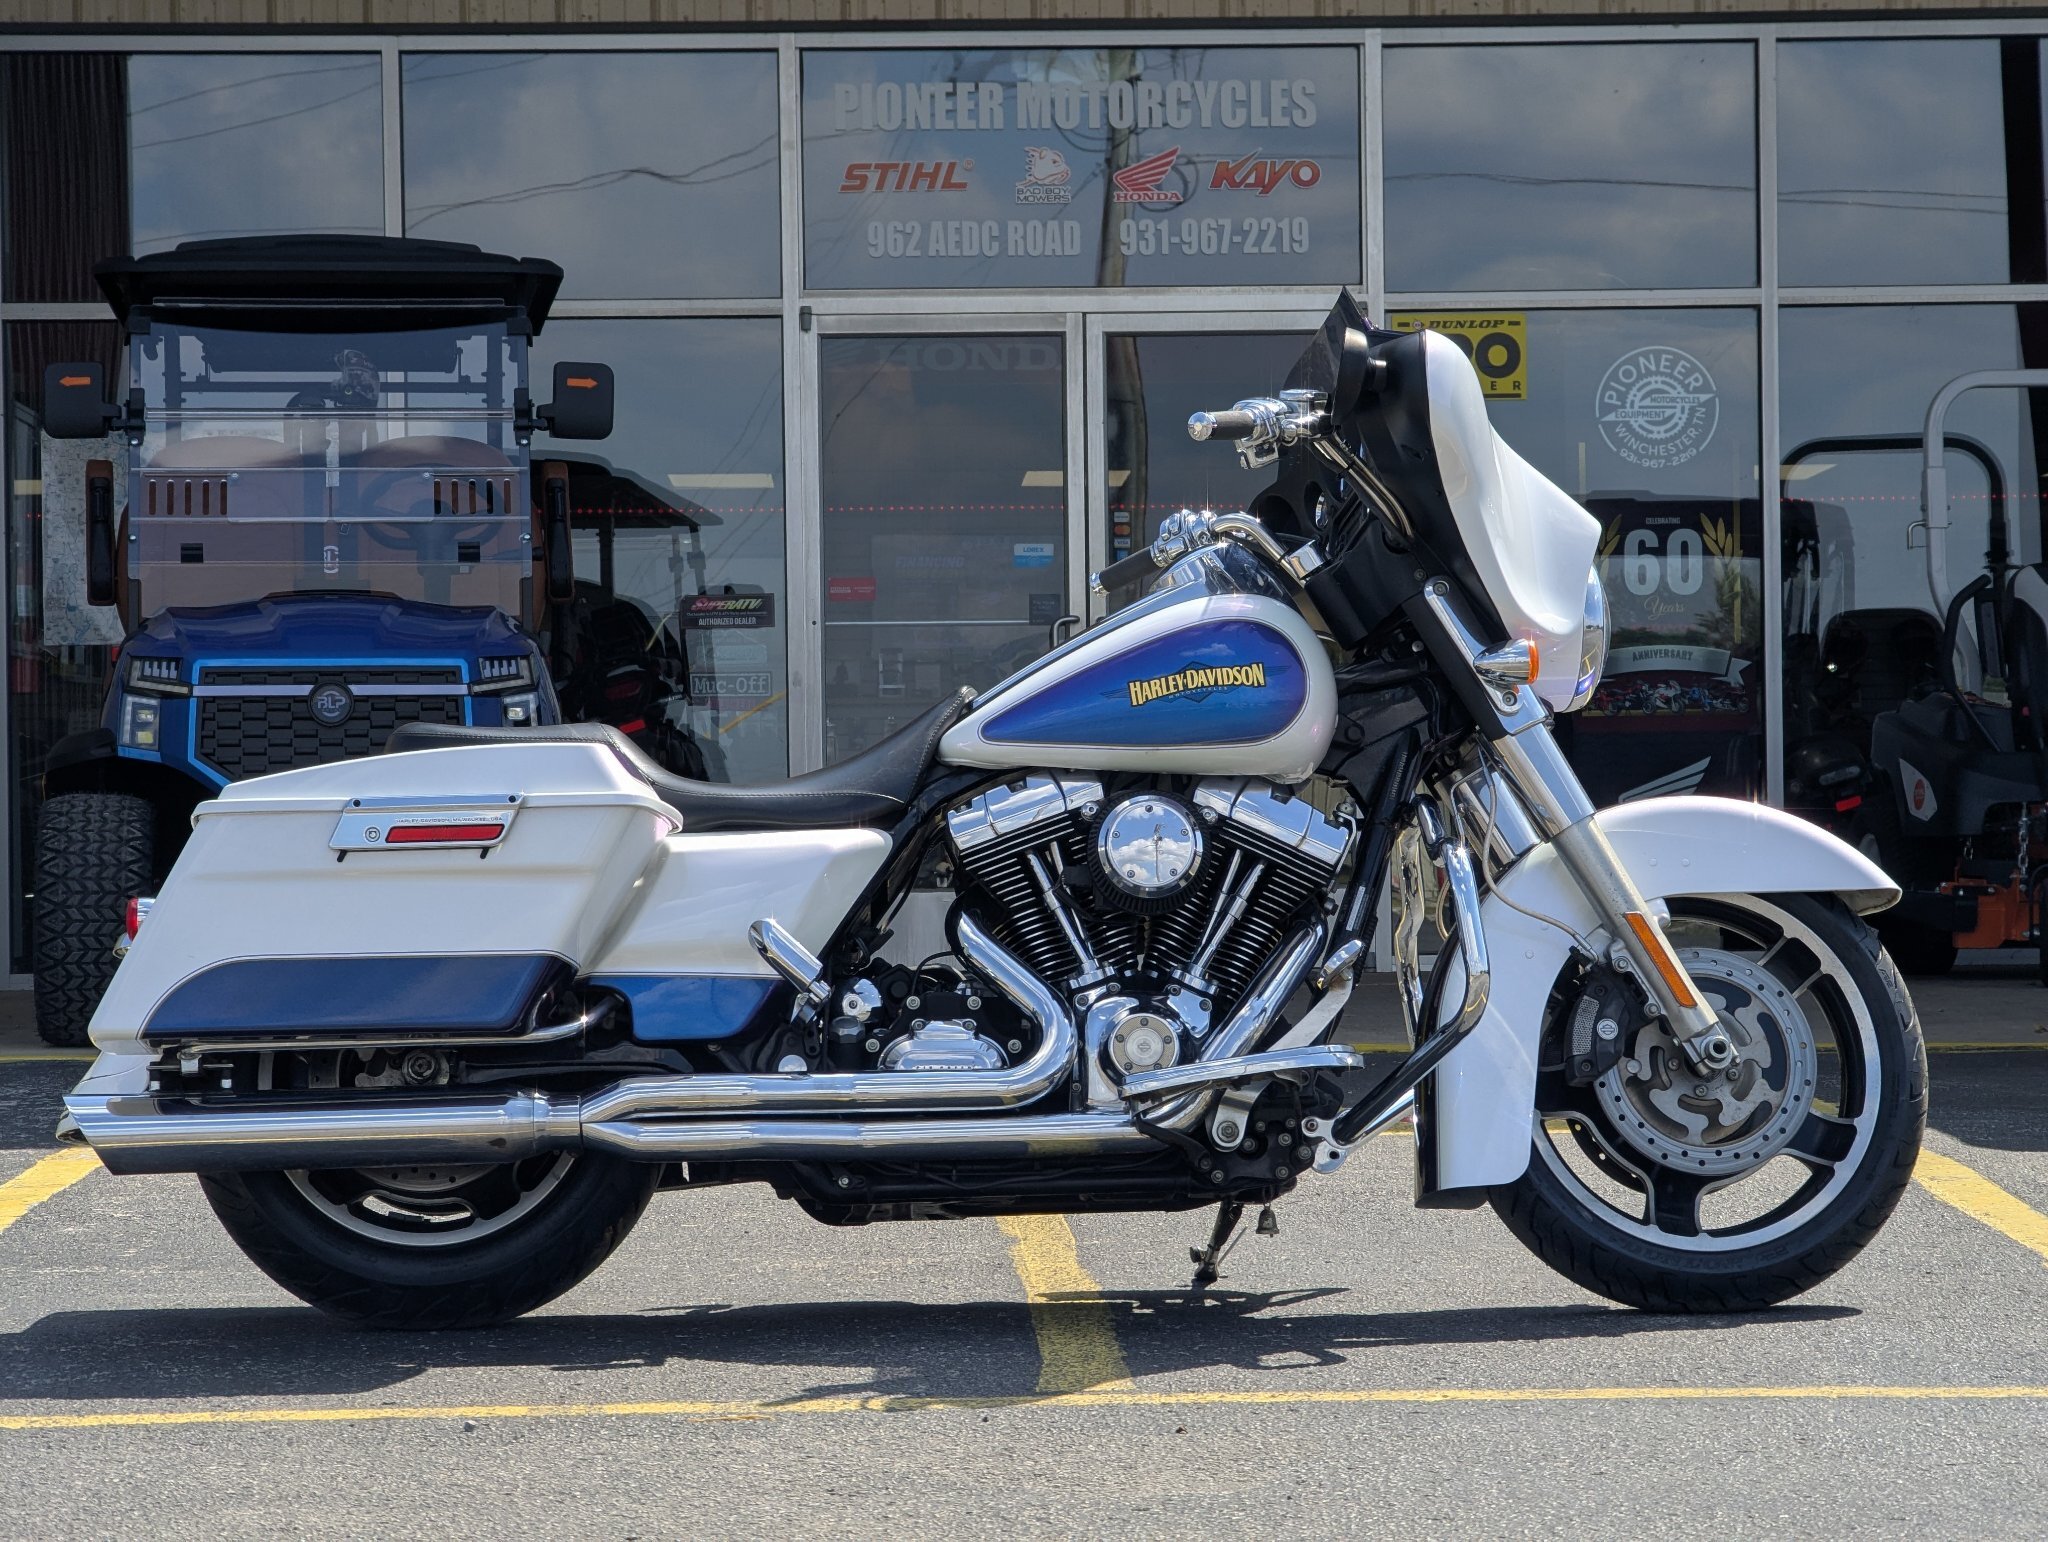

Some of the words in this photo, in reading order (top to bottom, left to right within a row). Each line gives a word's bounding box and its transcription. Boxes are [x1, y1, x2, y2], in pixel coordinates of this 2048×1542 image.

[834, 81, 1004, 131] PIONEER
[1016, 79, 1317, 130] MOTORCYCLES
[1209, 147, 1321, 197] KAYO
[1016, 187, 1042, 195] BAD
[1045, 186, 1070, 195] BOY
[1016, 194, 1070, 203] MOWERS
[1114, 191, 1184, 202] HONDA
[867, 220, 922, 258] 962
[927, 220, 1000, 258] AEDC
[1007, 219, 1080, 257] ROAD
[1119, 217, 1310, 256] 931-967-2219
[1428, 320, 1506, 329] DUNLOP
[874, 342, 1062, 372] HOND
[1604, 353, 1704, 406] PIONEER
[1615, 410, 1666, 419] EQUIPMENT
[1692, 407, 1706, 425] TN
[1619, 447, 1698, 469] 931-967-2219
[1645, 517, 1681, 525] CELEBRATING
[1624, 528, 1703, 596] 60
[1643, 595, 1686, 621] Years
[698, 617, 733, 626] AUTHORIZED
[735, 616, 757, 625] DEALER
[1632, 648, 1693, 662] ANNIVERSARY
[693, 677, 767, 694] Muc-Off
